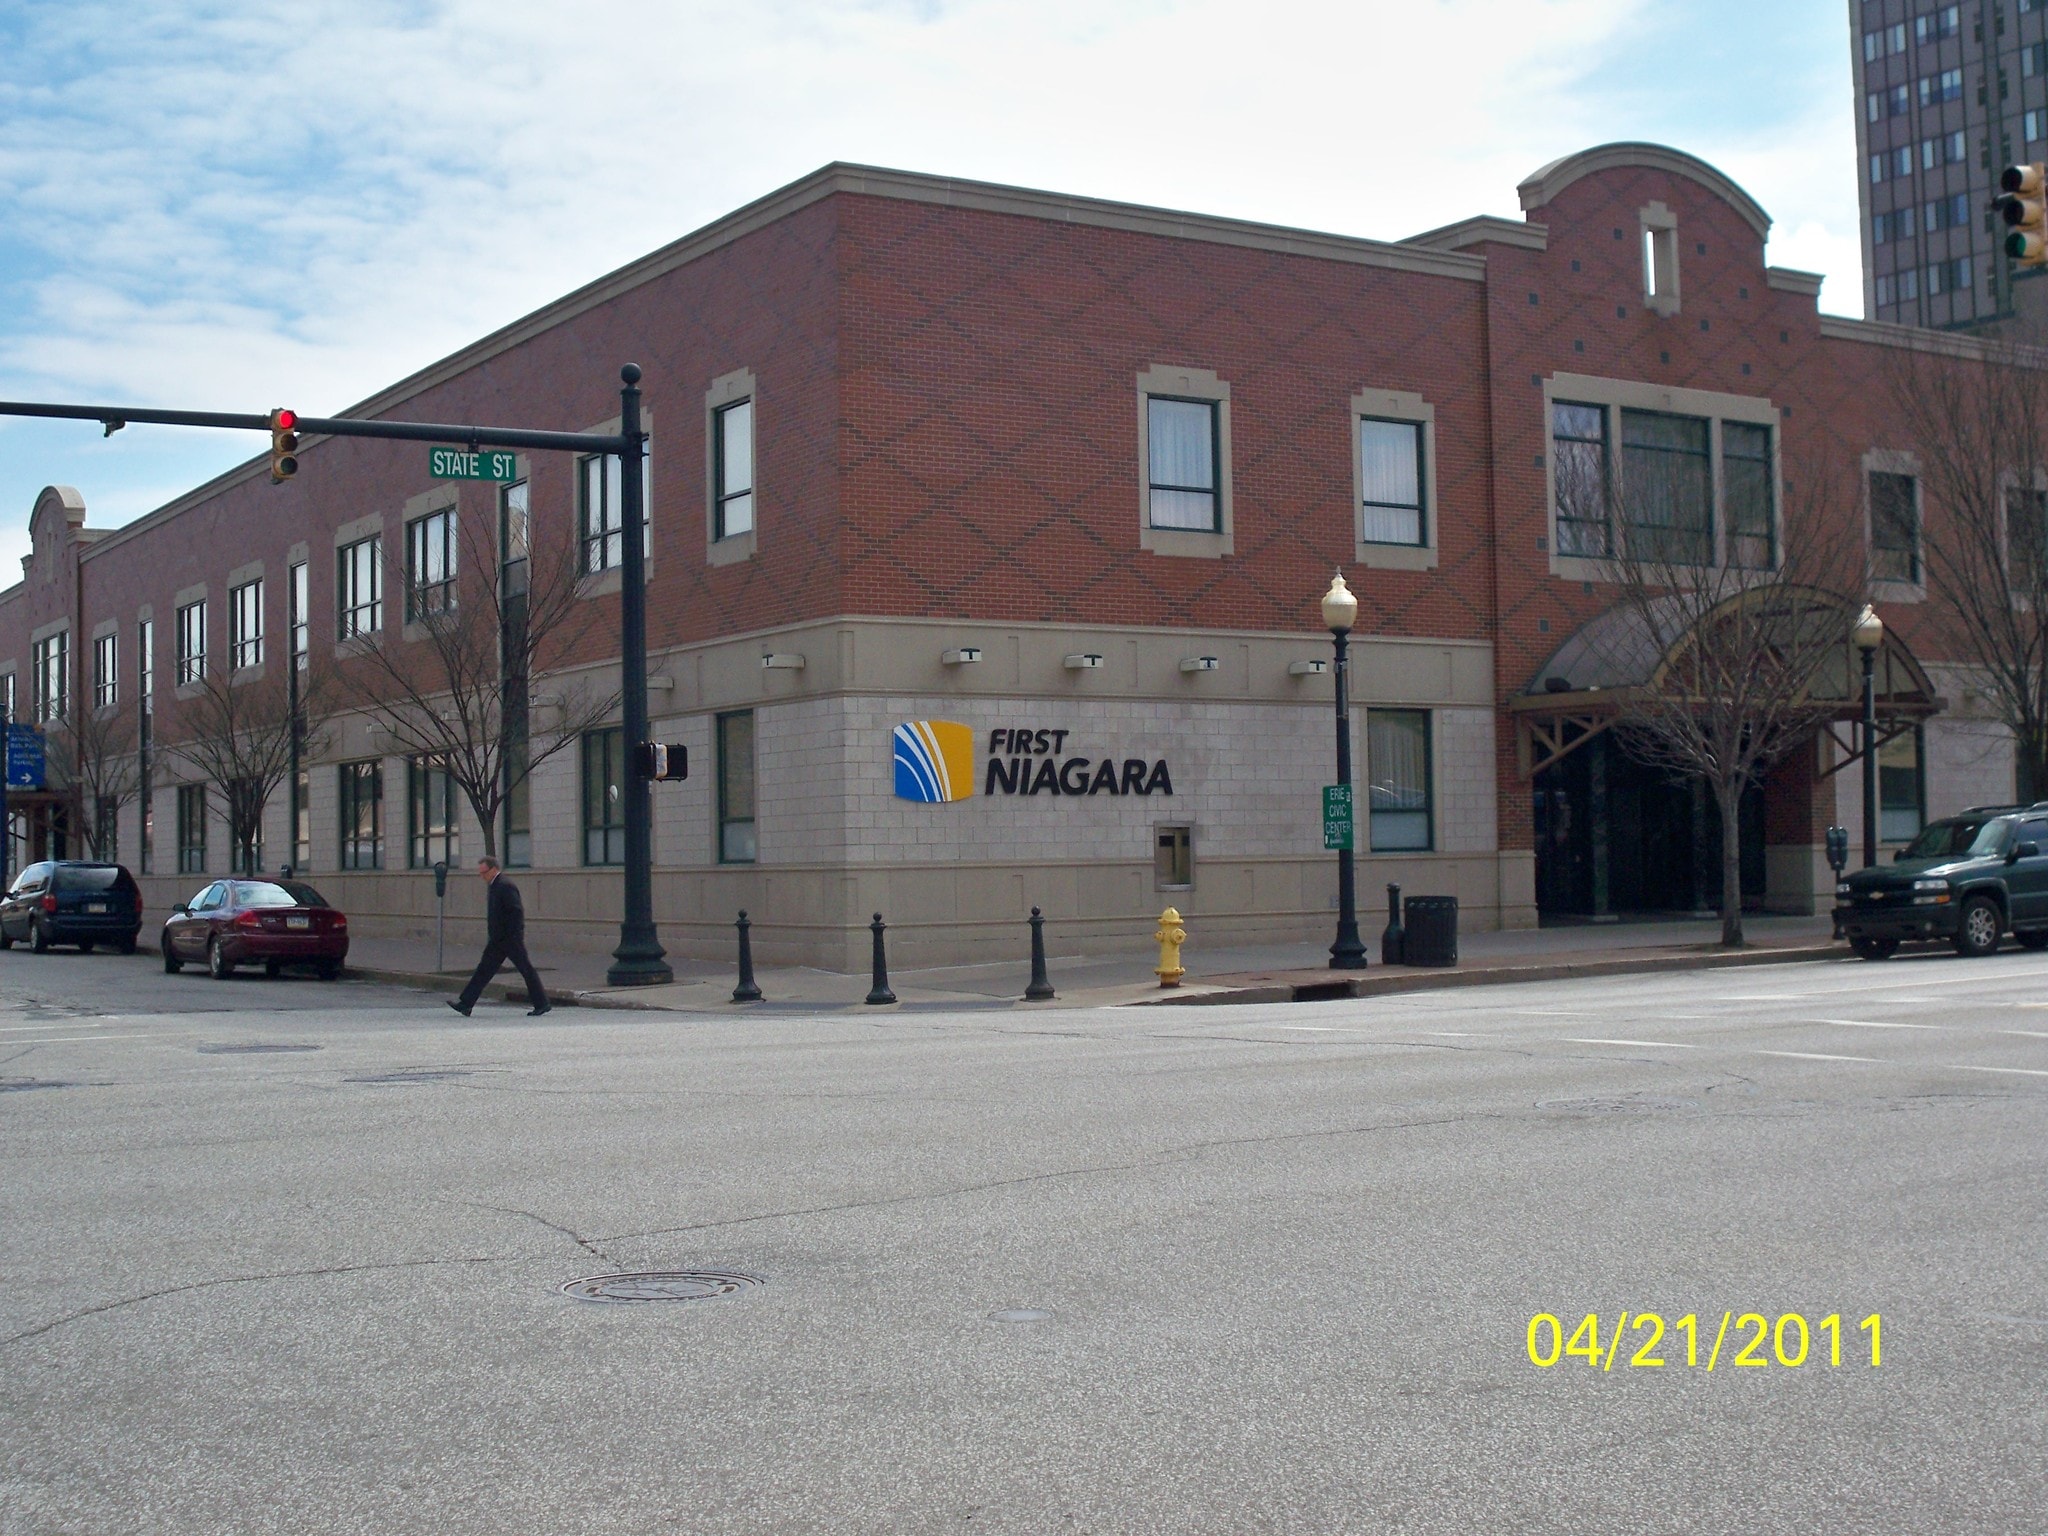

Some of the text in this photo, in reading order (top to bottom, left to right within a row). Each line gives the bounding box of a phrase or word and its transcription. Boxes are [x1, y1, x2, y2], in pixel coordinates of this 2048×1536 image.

[433, 450, 513, 478] STATE ST
[988, 728, 1070, 755] FIRST
[984, 757, 1174, 796] NIAGARA
[1329, 787, 1345, 801] ERIE
[1328, 803, 1347, 818] CIVIC
[1325, 820, 1352, 834] CENTER
